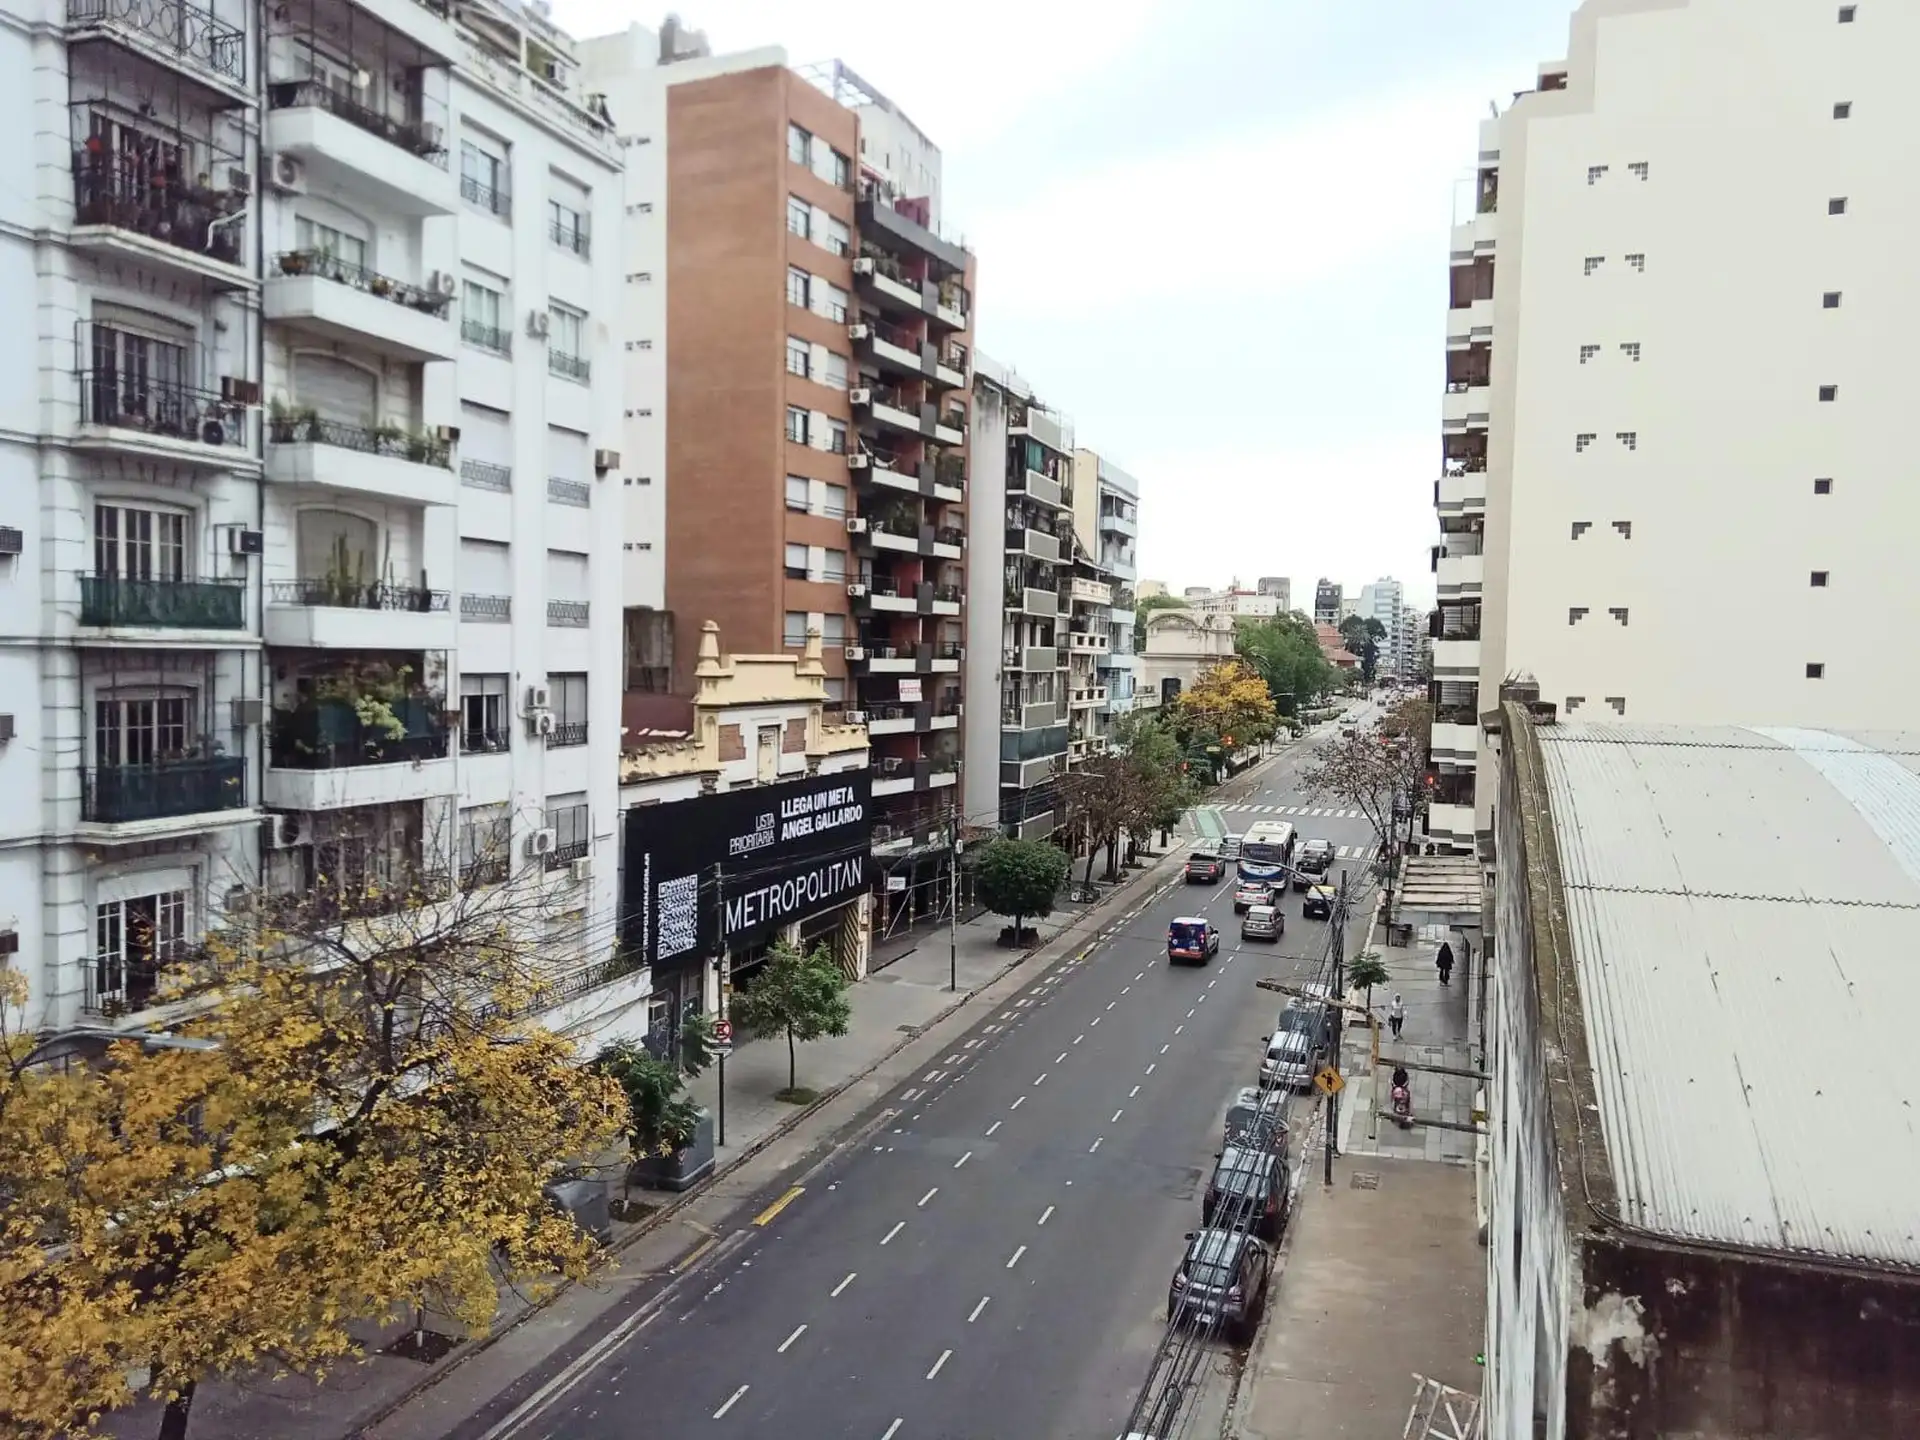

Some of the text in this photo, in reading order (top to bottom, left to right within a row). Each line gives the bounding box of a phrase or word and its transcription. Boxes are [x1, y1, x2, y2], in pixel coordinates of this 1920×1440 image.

[781, 786, 854, 818] LLEGA UN META
[755, 813, 775, 829] LISTA
[781, 804, 863, 841] ANGEL GALLARDO
[729, 830, 775, 852] PRIORITARIA
[725, 856, 862, 934] METROPOLITAN
